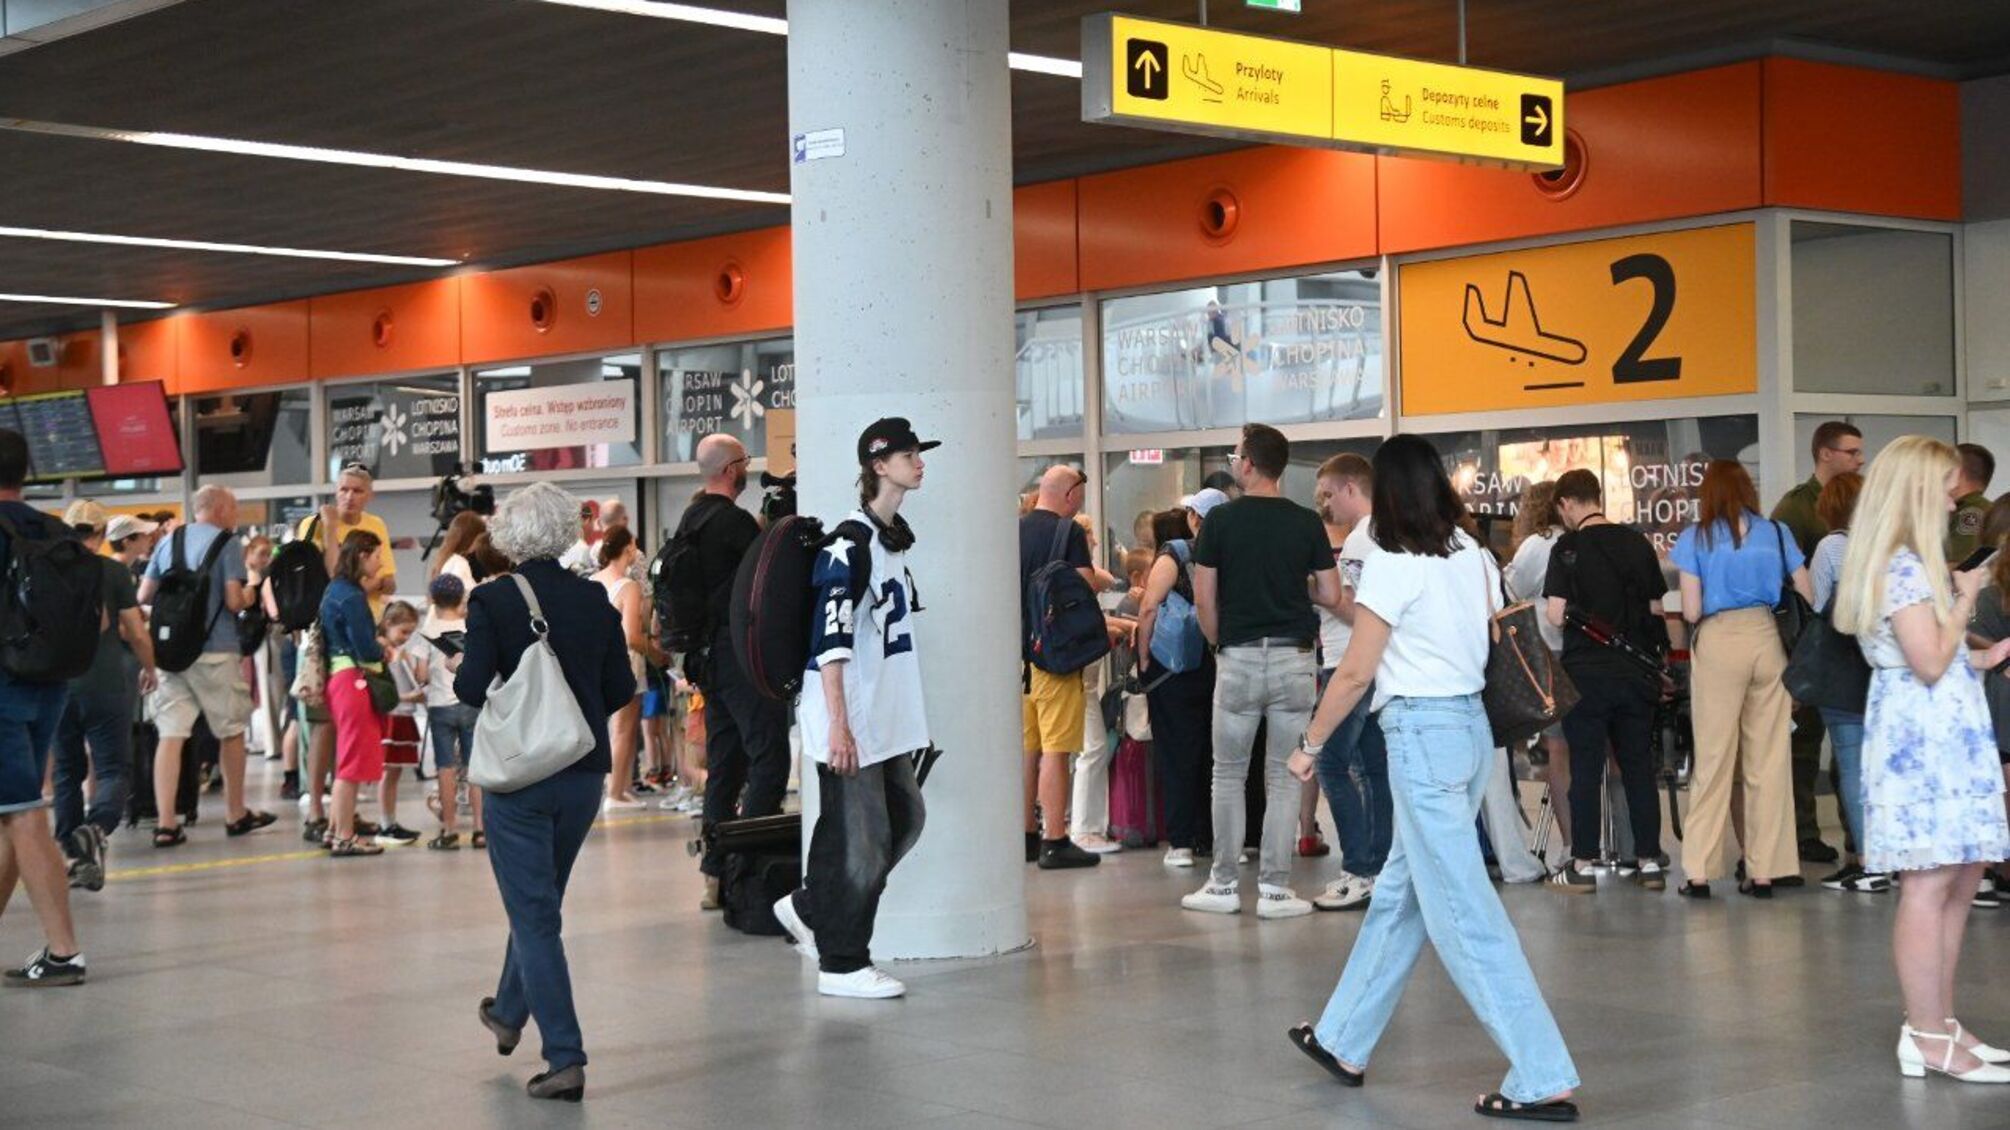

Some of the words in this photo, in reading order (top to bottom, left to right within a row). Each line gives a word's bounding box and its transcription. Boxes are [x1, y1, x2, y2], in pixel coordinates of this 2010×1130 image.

[1236, 62, 1284, 85] Przyloty
[1237, 87, 1280, 104] Arrivals
[1422, 88, 1470, 109] Depozyty
[1472, 95, 1500, 110] celne
[1422, 111, 1466, 128] Customs
[1468, 117, 1511, 133] deposits
[1610, 253, 1682, 384] 2
[412, 420, 458, 437] CHOPINA
[824, 599, 854, 636] 24
